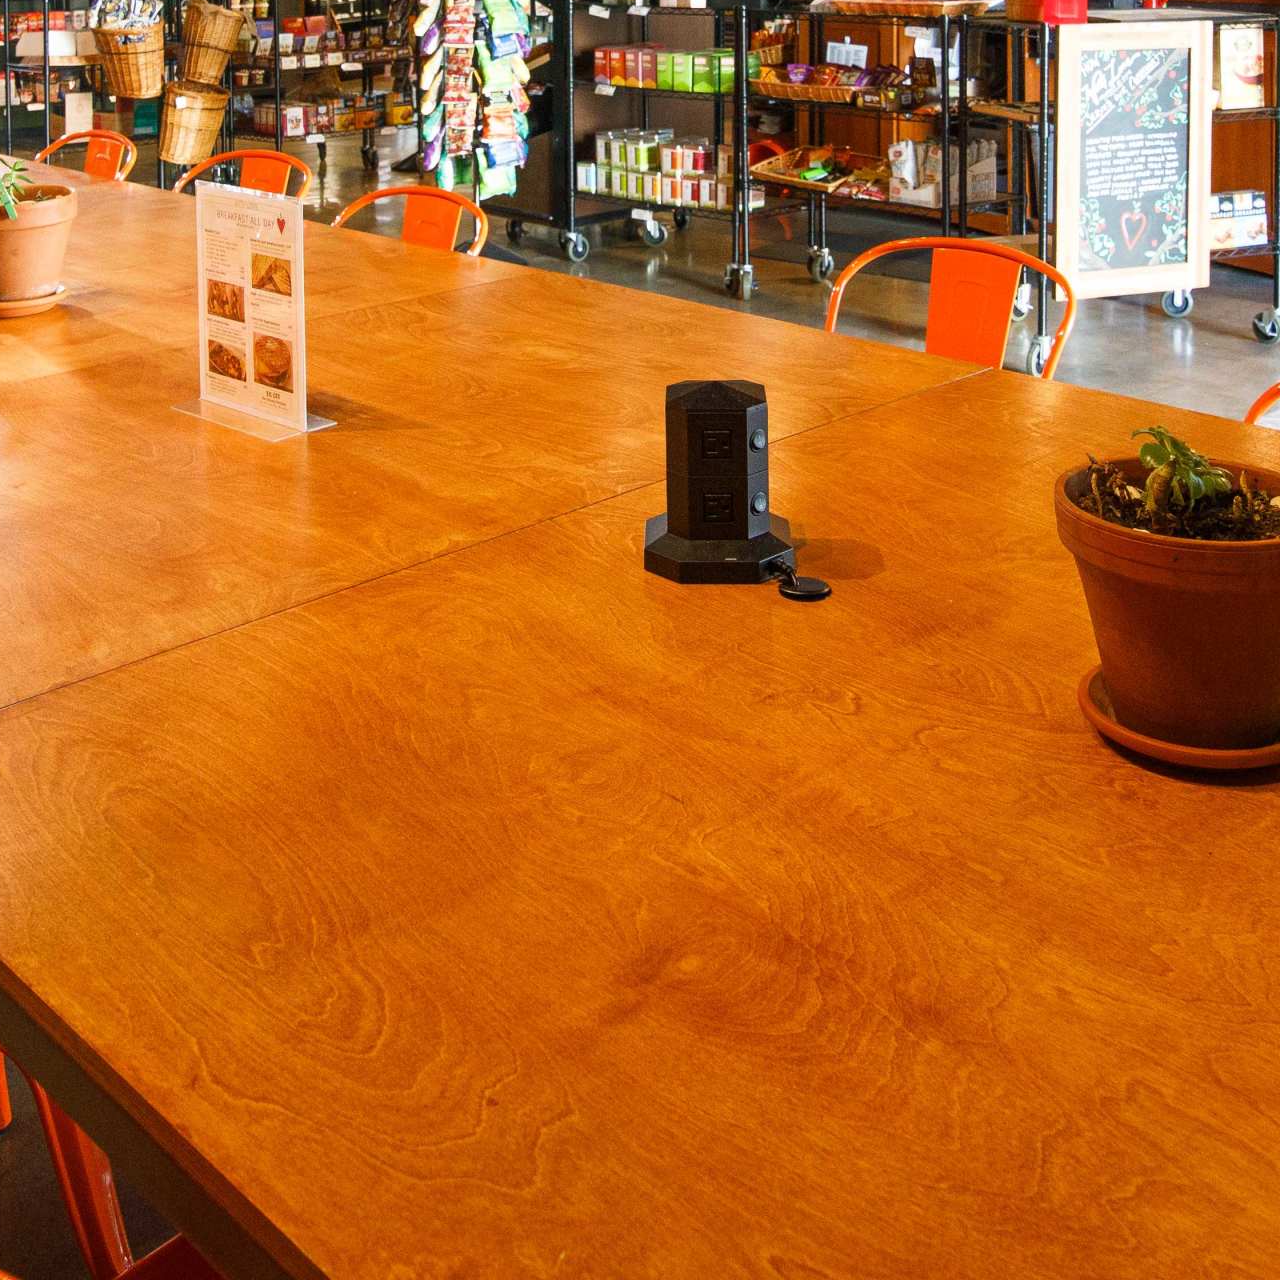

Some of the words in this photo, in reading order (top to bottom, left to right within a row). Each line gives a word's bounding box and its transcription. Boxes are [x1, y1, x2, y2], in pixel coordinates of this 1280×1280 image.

[216, 210, 249, 225] BREAKFAST
[250, 216, 261, 226] ALL
[263, 218, 275, 228] DAY
